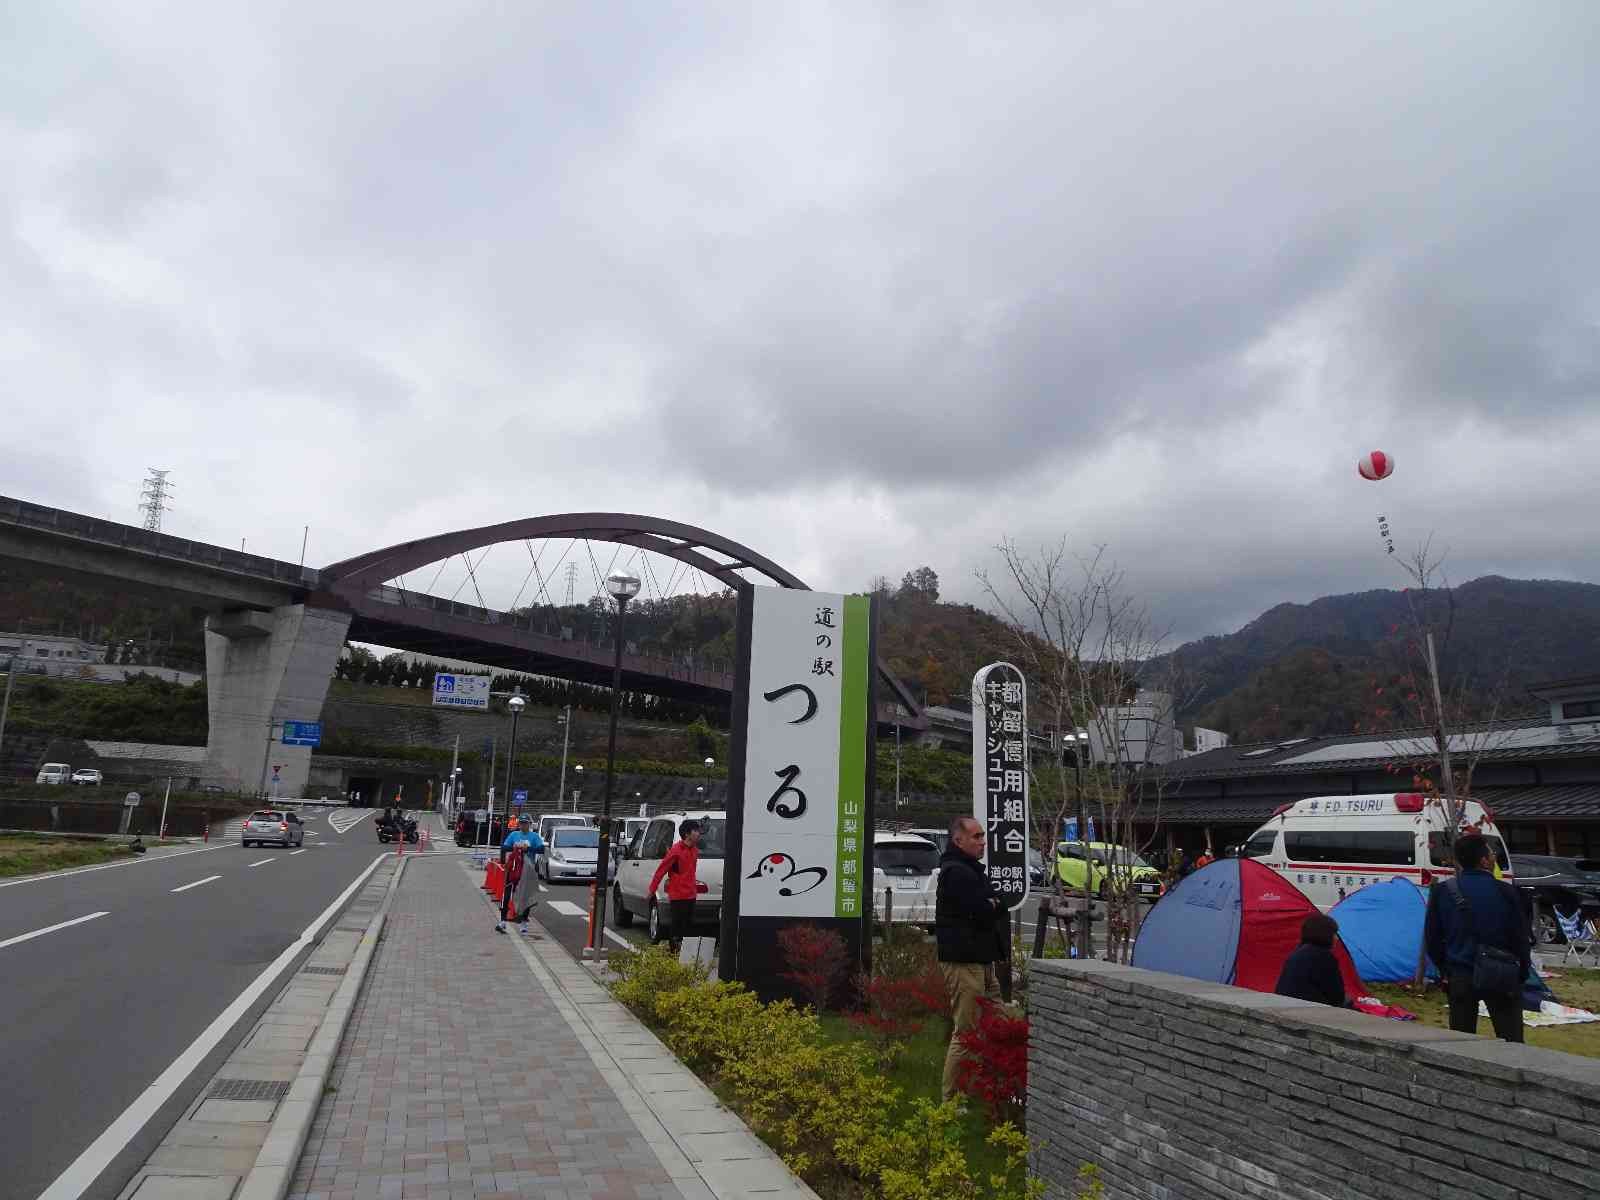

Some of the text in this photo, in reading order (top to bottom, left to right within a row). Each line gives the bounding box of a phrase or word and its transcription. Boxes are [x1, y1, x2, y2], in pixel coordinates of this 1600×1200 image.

[811, 607, 836, 677] 道の駅
[763, 683, 818, 819] つる
[985, 680, 1004, 853] キャッシュコーナー
[1001, 681, 1025, 853] 都留信用組合
[1346, 800, 1384, 812] TSURU
[990, 865, 1023, 879] 道の駅
[991, 880, 1023, 893] つる内
